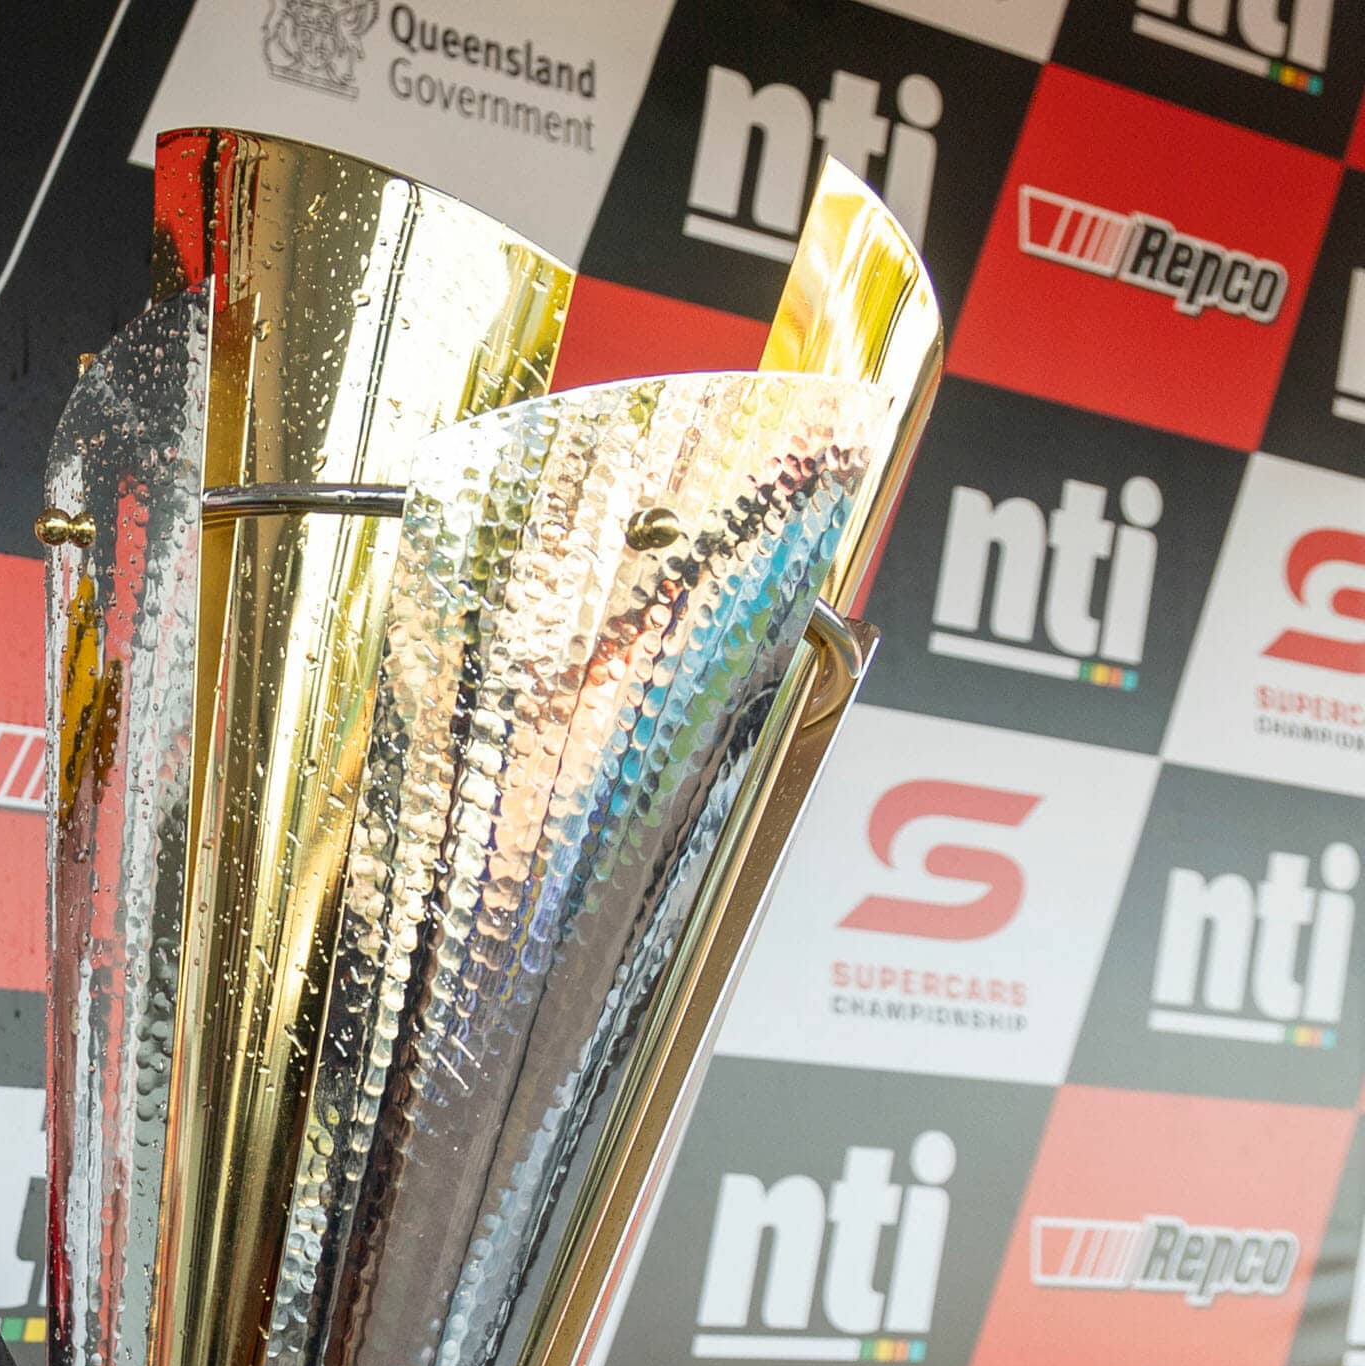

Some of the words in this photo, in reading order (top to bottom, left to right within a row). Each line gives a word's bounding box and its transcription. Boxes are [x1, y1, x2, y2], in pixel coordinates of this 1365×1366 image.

[389, 4, 596, 99] Queensland
[388, 57, 596, 151] Government
[1124, 215, 1286, 321] Repco
[932, 475, 1164, 665] nti
[1152, 842, 1361, 1025] nti
[829, 995, 1028, 1032] CHAMPIONSHIP
[831, 960, 1028, 1007] SUPERCARS
[696, 1130, 957, 1333] nti
[1138, 1215, 1300, 1305] Repco
